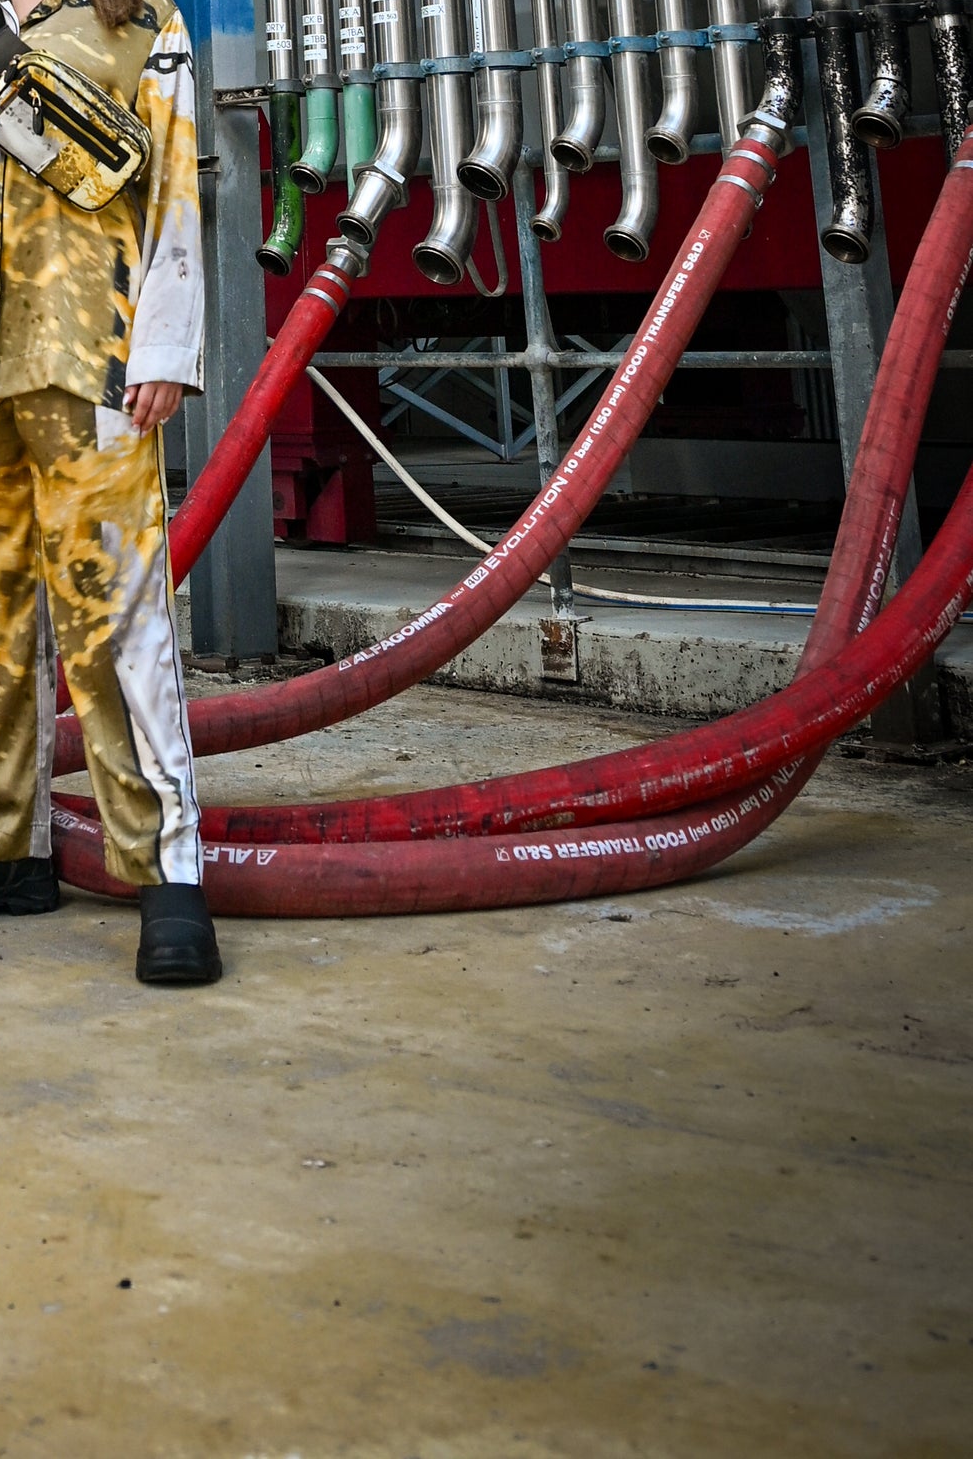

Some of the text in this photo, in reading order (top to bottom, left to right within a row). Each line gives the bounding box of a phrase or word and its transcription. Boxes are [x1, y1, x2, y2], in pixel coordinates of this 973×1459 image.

[353, 241, 705, 666] ALFAGOMMA ITALY 402 EVOLUTION 10 bar (150 psi) FOOD TRANSFER S&D
[758, 784, 775, 803] 10
[738, 794, 761, 816] bar
[687, 821, 712, 842] psi)
[710, 808, 740, 833] (150
[554, 837, 644, 859] TRANSFER
[644, 829, 689, 851] FOOD
[203, 846, 255, 864] ALF
[512, 844, 553, 860] S&D
